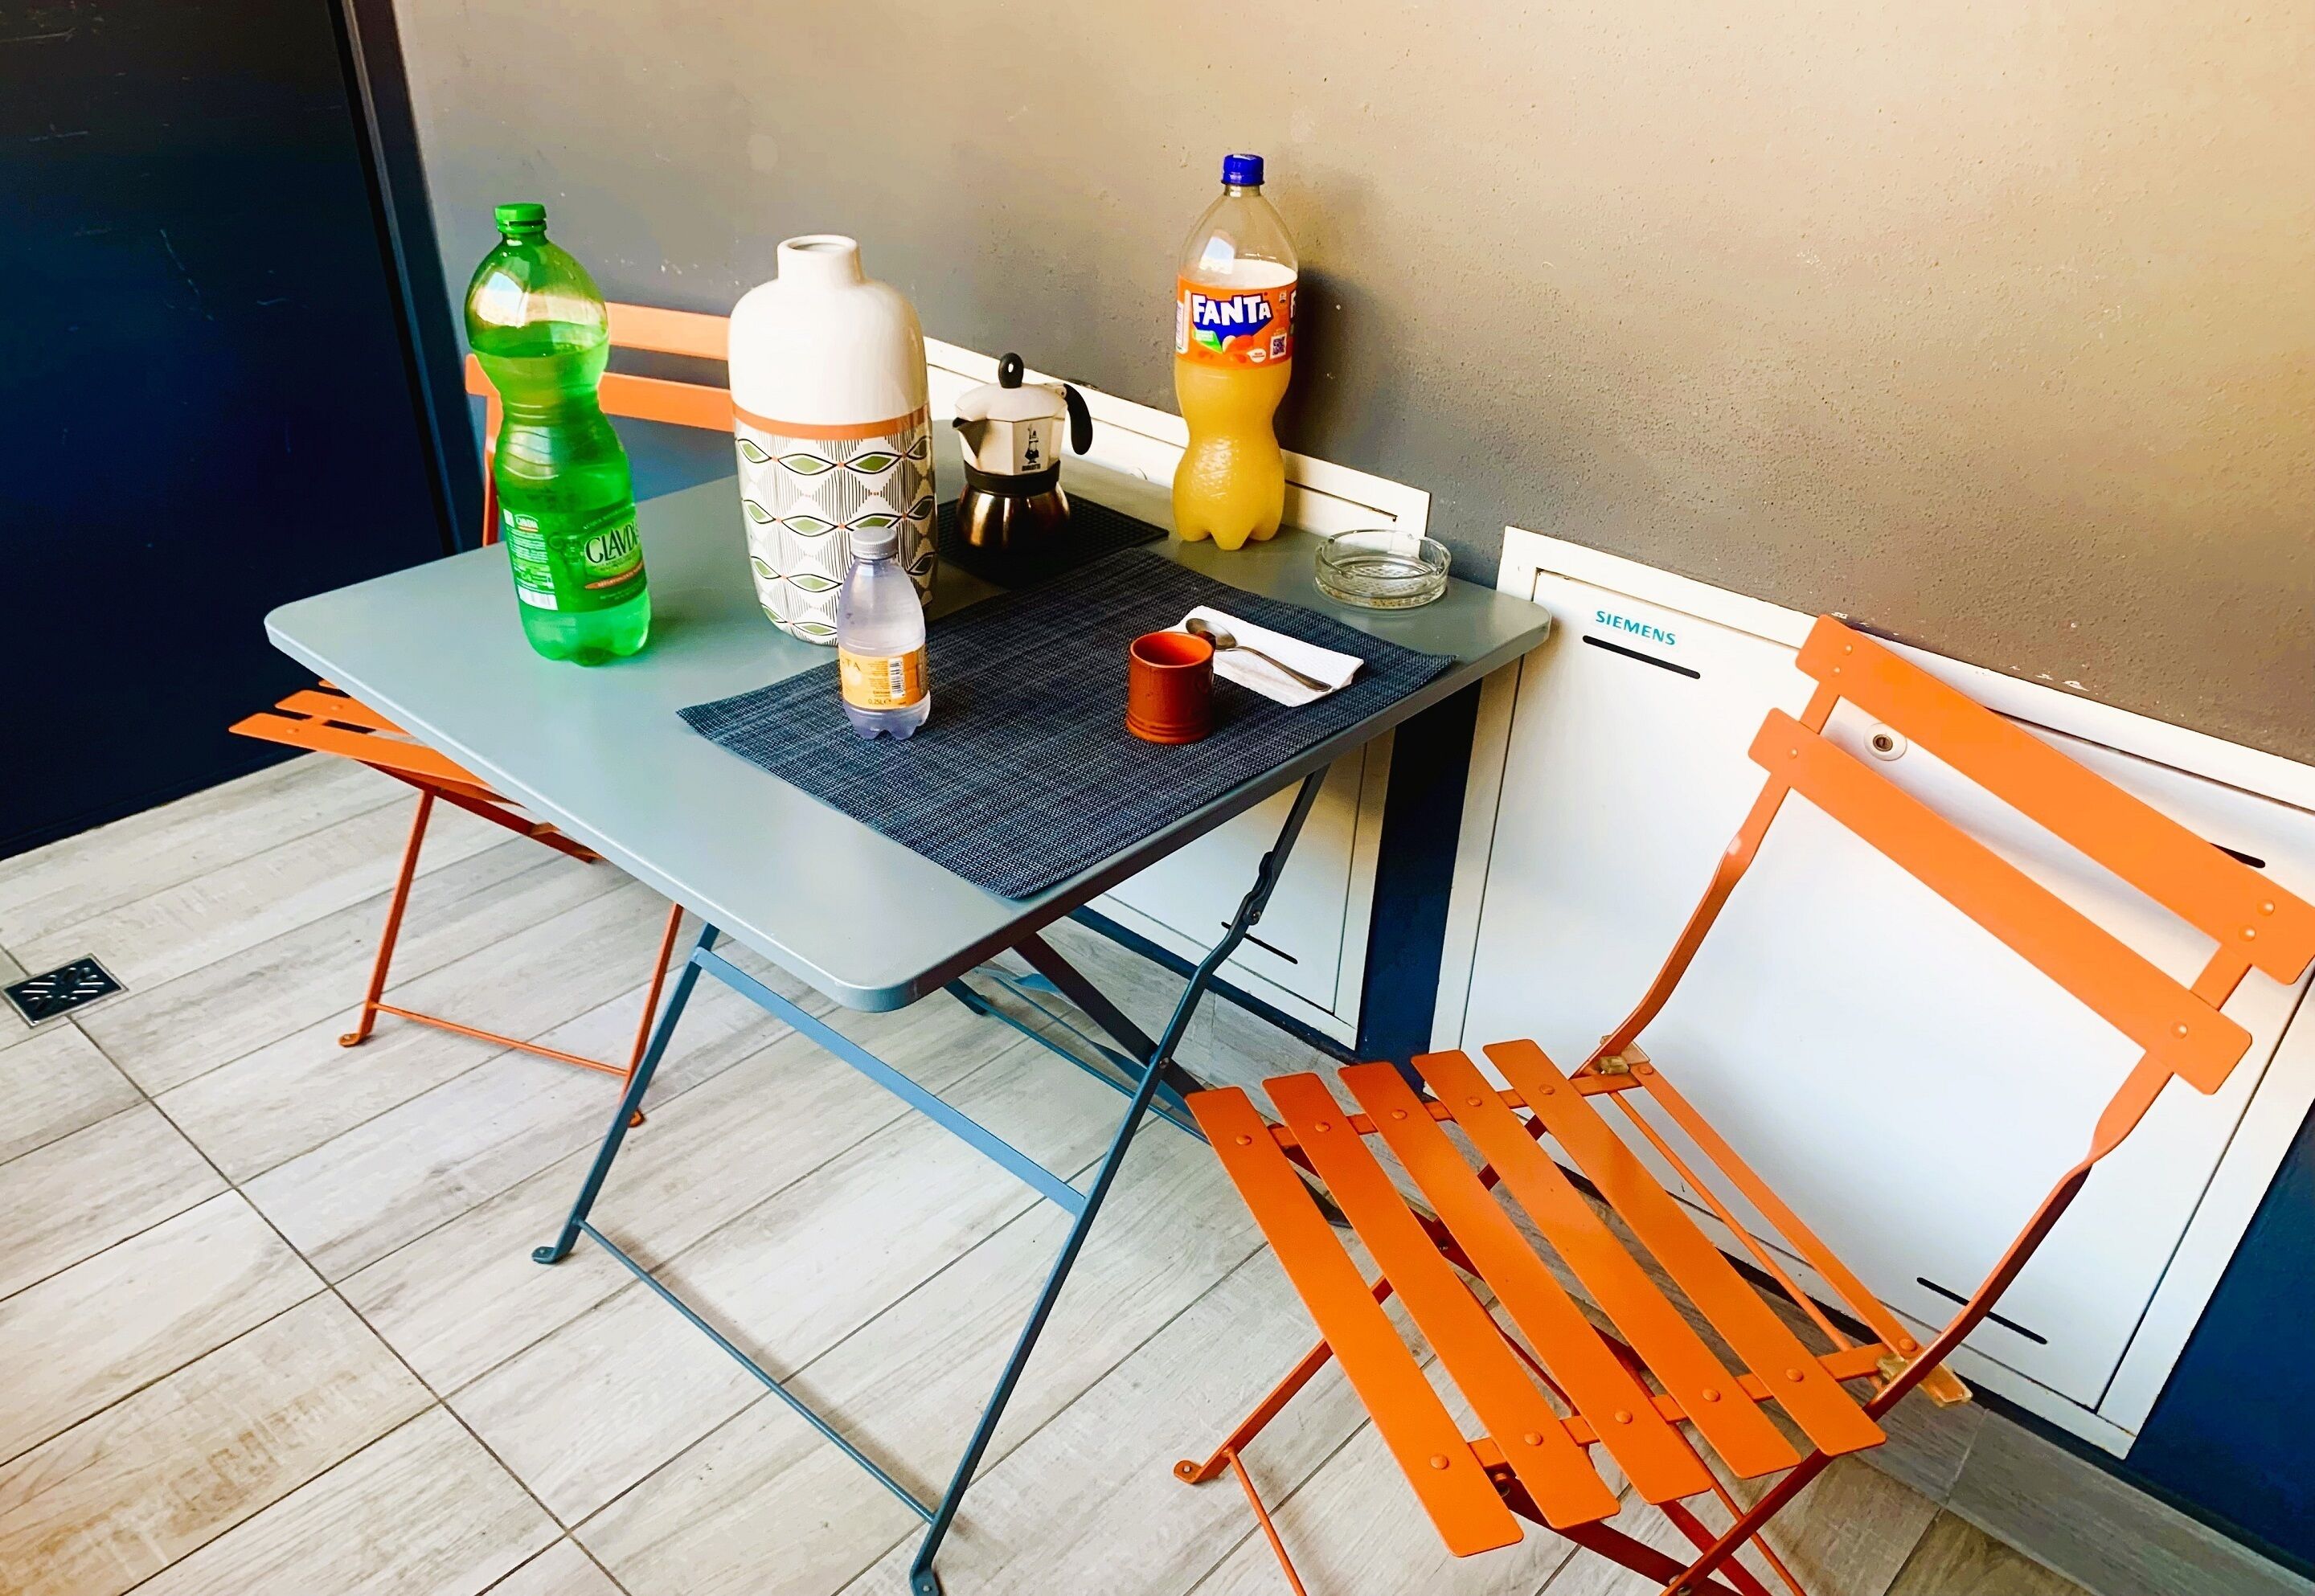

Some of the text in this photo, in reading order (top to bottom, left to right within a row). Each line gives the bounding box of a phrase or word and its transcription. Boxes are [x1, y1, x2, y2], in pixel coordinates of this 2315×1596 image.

[1191, 294, 1272, 326] FANTA
[585, 522, 640, 564] CLAVDI
[1595, 610, 1676, 646] SIEMENS
